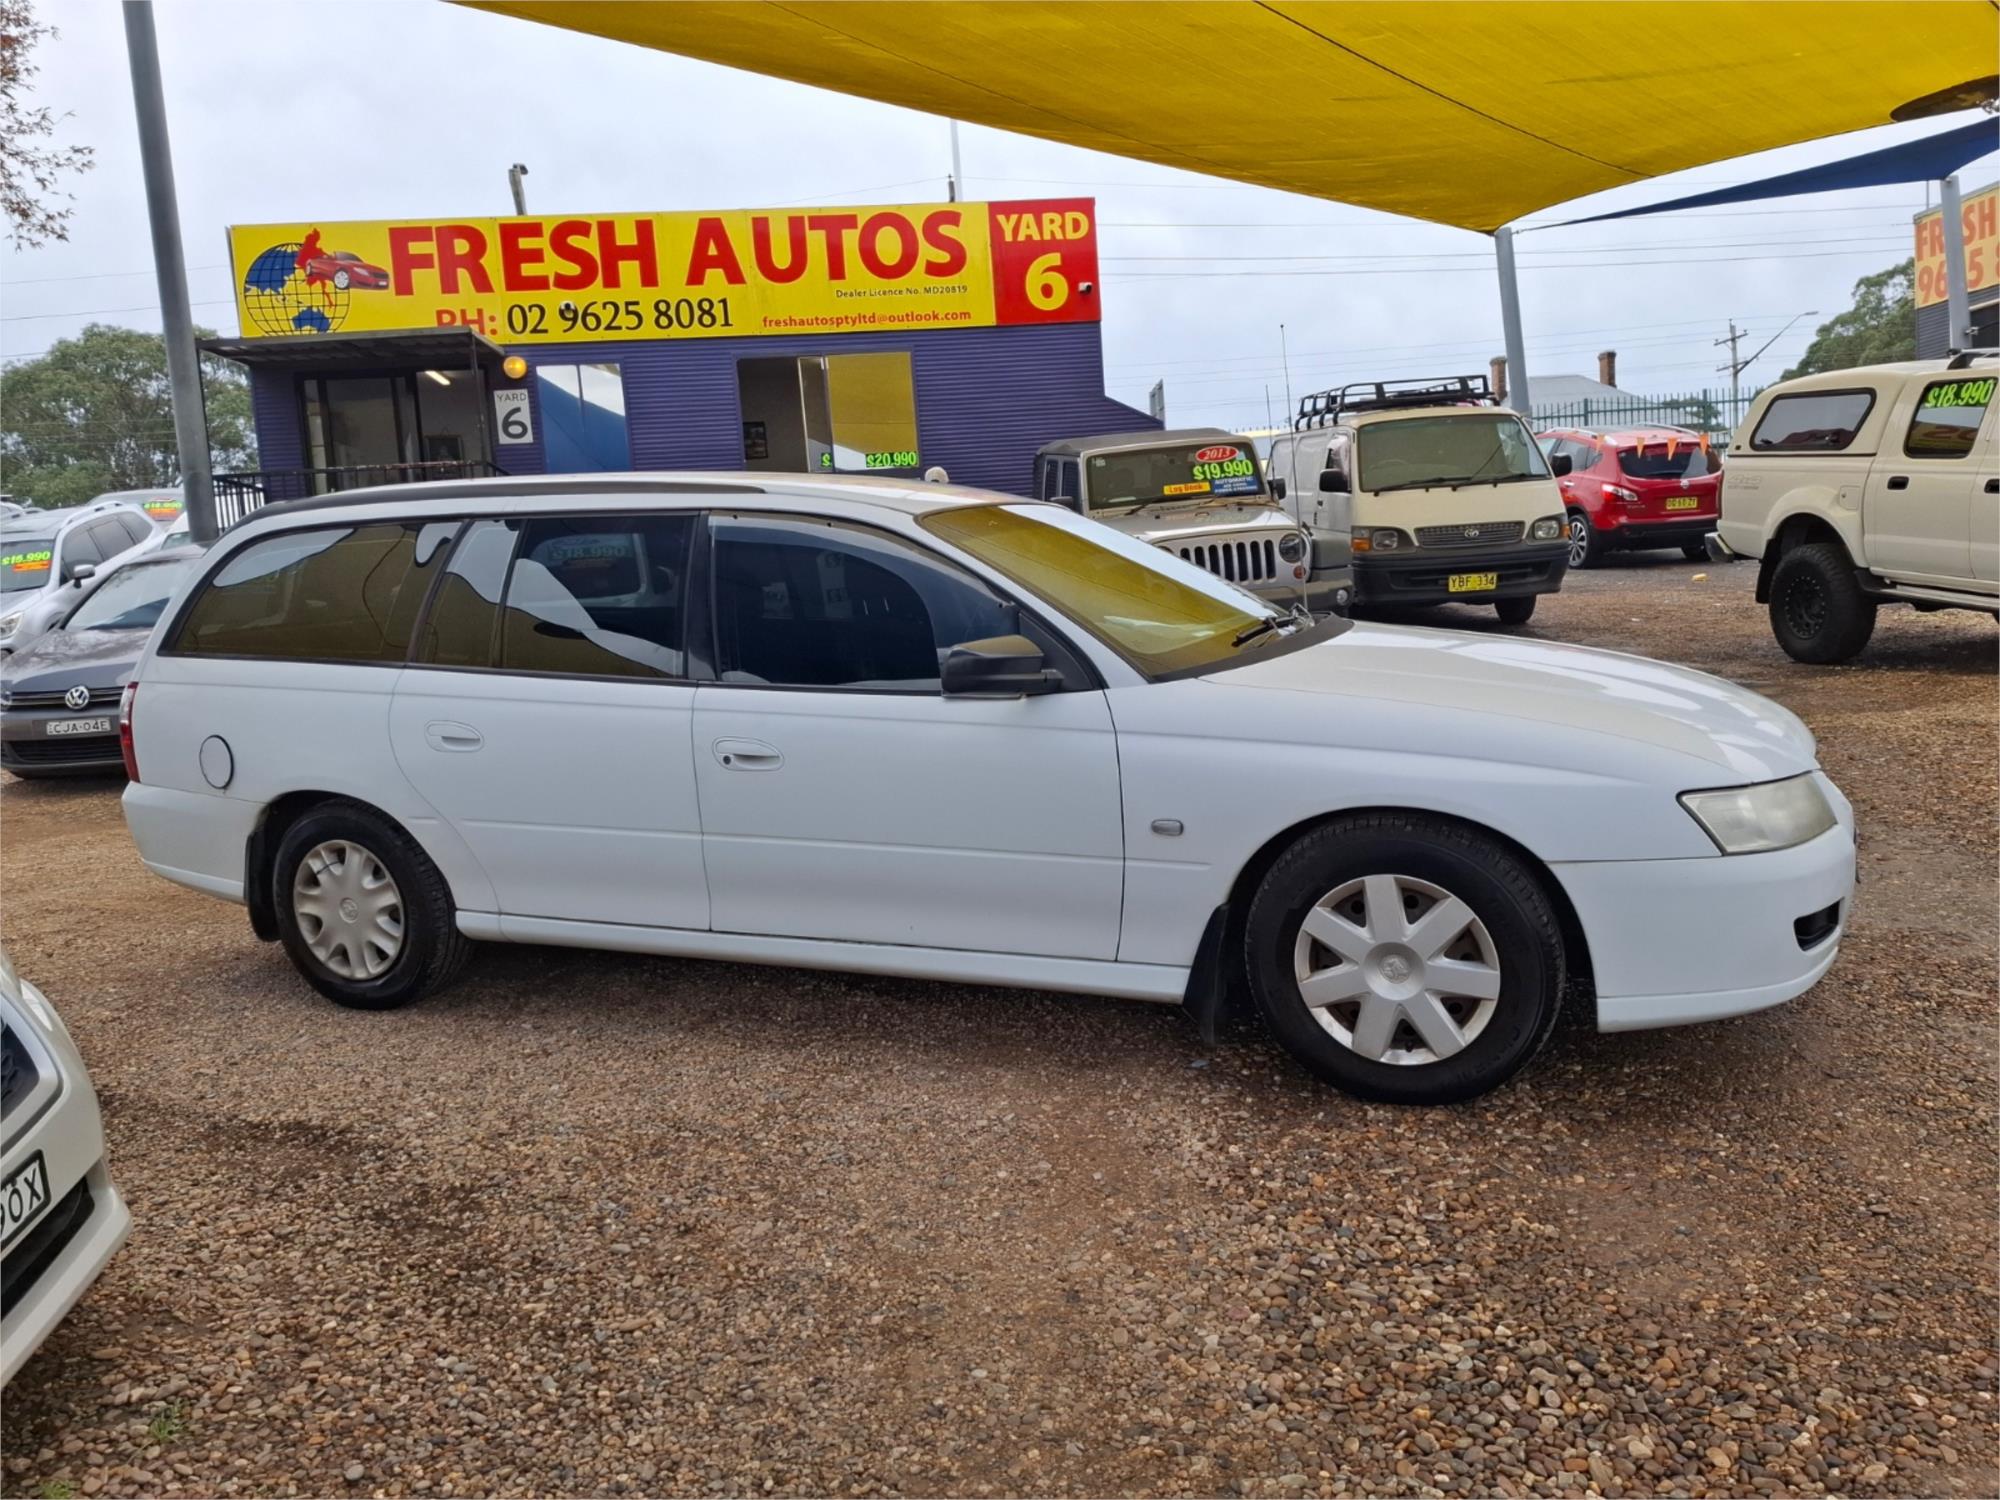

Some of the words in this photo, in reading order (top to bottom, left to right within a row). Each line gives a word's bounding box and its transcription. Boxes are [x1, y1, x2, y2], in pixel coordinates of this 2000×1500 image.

[996, 211, 1090, 242] YARD
[1916, 196, 1996, 262] FRSH
[388, 218, 659, 297] FRESH
[685, 210, 968, 286] AUTOS
[1025, 253, 1069, 311] 6
[1918, 246, 1985, 304] 965
[836, 289, 866, 298] Dealer
[869, 287, 903, 297] Licence
[905, 286, 920, 296] No.
[923, 284, 968, 295] MD20819
[436, 308, 497, 336] PH:
[507, 303, 549, 334] 02
[559, 298, 643, 333] 9625
[654, 297, 733, 331] 8081
[763, 310, 971, 329] freshautosptyltd@outlook.com
[497, 392, 527, 402] YARD
[502, 406, 529, 440] 6
[867, 451, 917, 467] $20.990
[1203, 448, 1231, 460] 2013
[1193, 460, 1254, 480] $19.990
[1451, 576, 1472, 588] YBF
